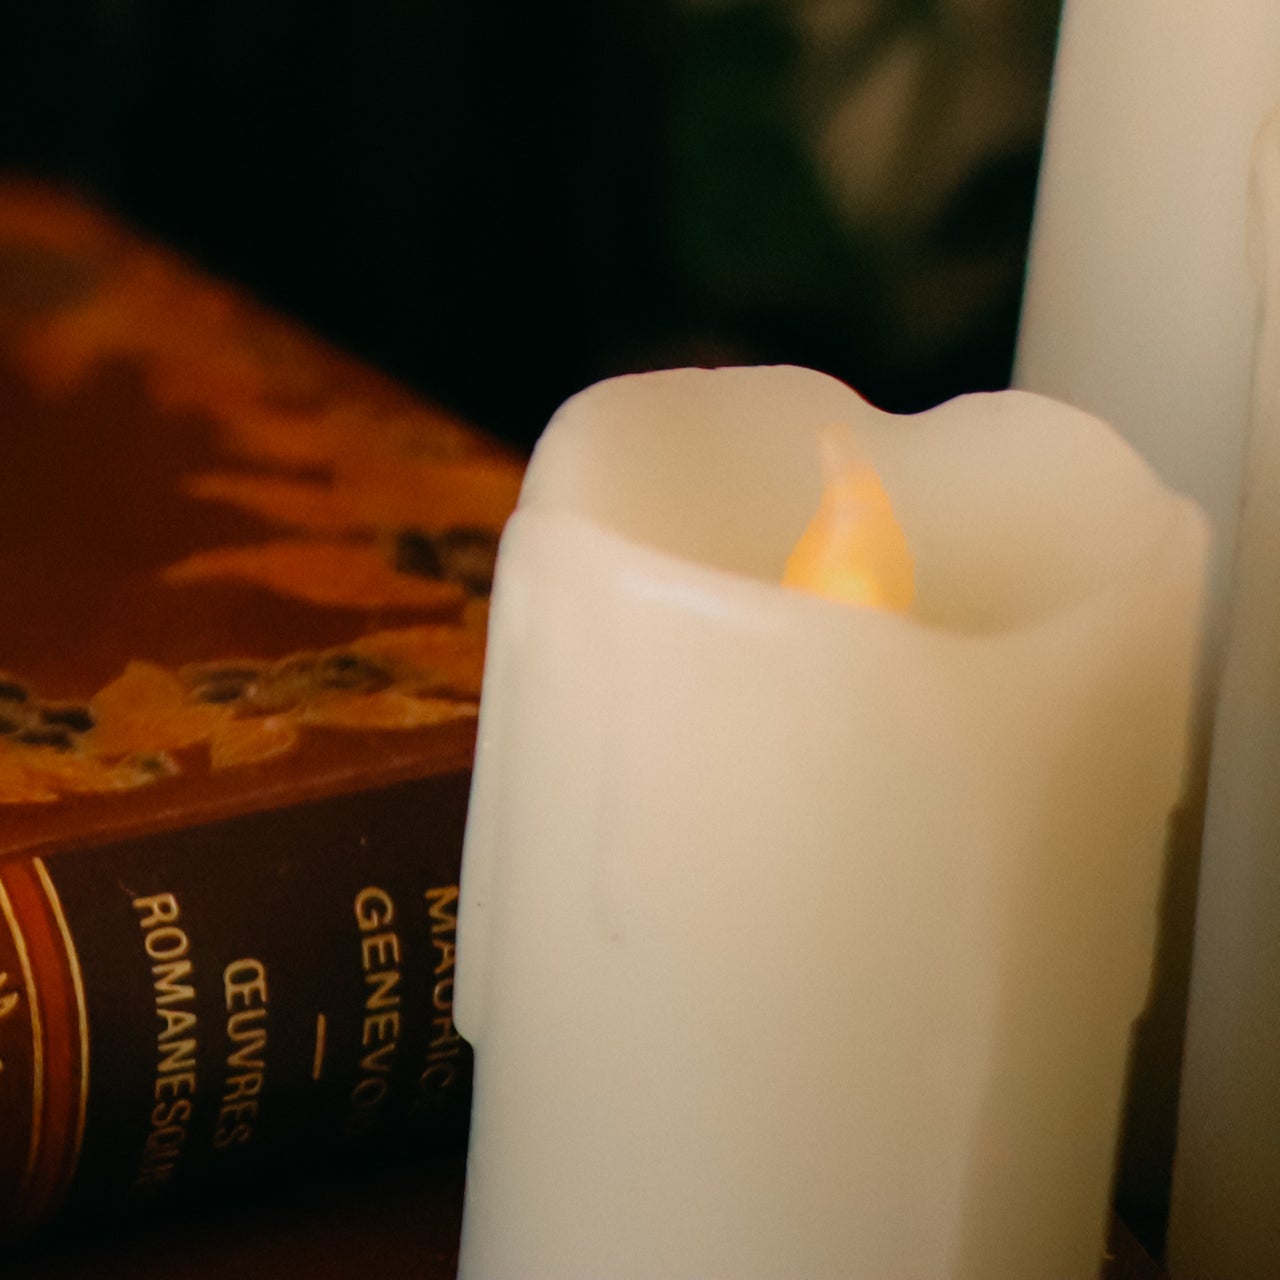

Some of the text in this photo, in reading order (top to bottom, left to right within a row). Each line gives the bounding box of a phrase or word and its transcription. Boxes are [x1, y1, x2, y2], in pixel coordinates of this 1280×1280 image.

[212, 957, 269, 1150] ŒUVRES
[348, 886, 401, 1131] GENEVO
[412, 884, 461, 1114] MAURIC
